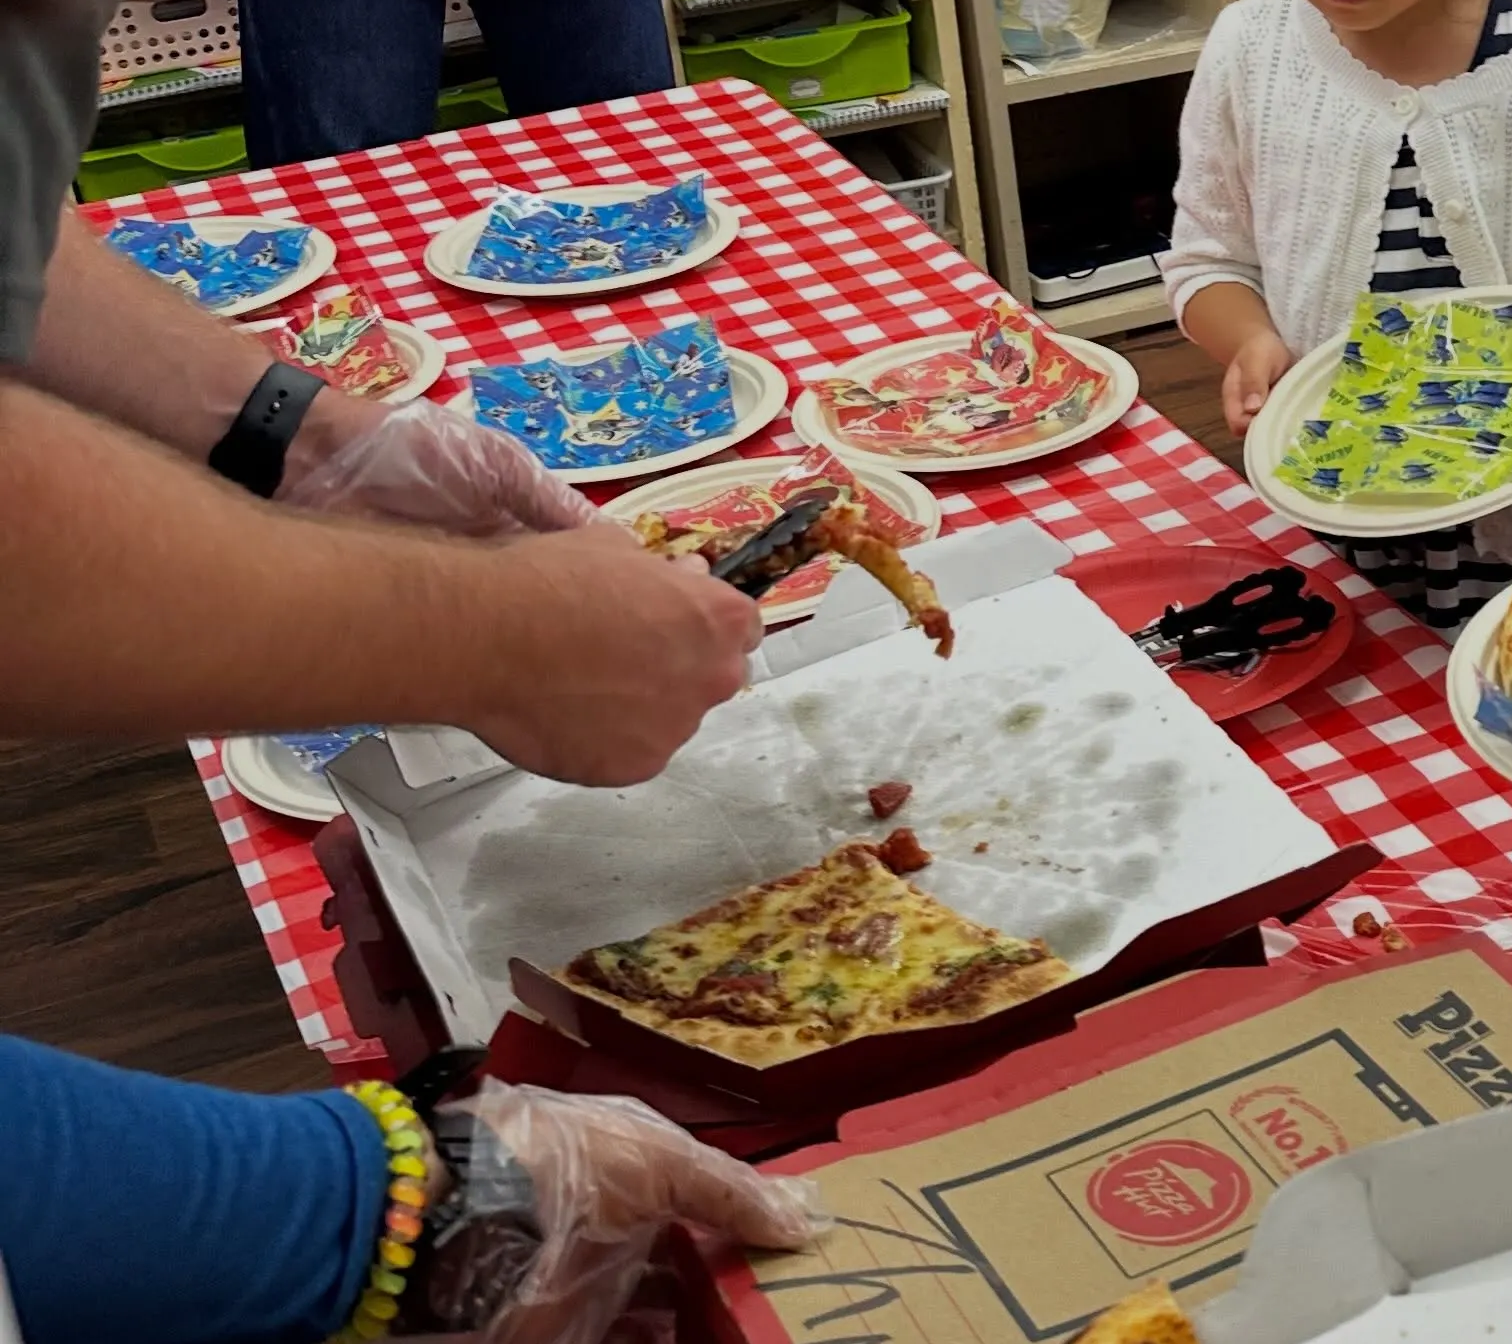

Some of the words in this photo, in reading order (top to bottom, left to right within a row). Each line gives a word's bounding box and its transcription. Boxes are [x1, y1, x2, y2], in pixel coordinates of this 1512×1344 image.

[1253, 1107, 1334, 1171] No.1
[1112, 1183, 1173, 1219] Hut
[1123, 1165, 1197, 1216] Pizza
